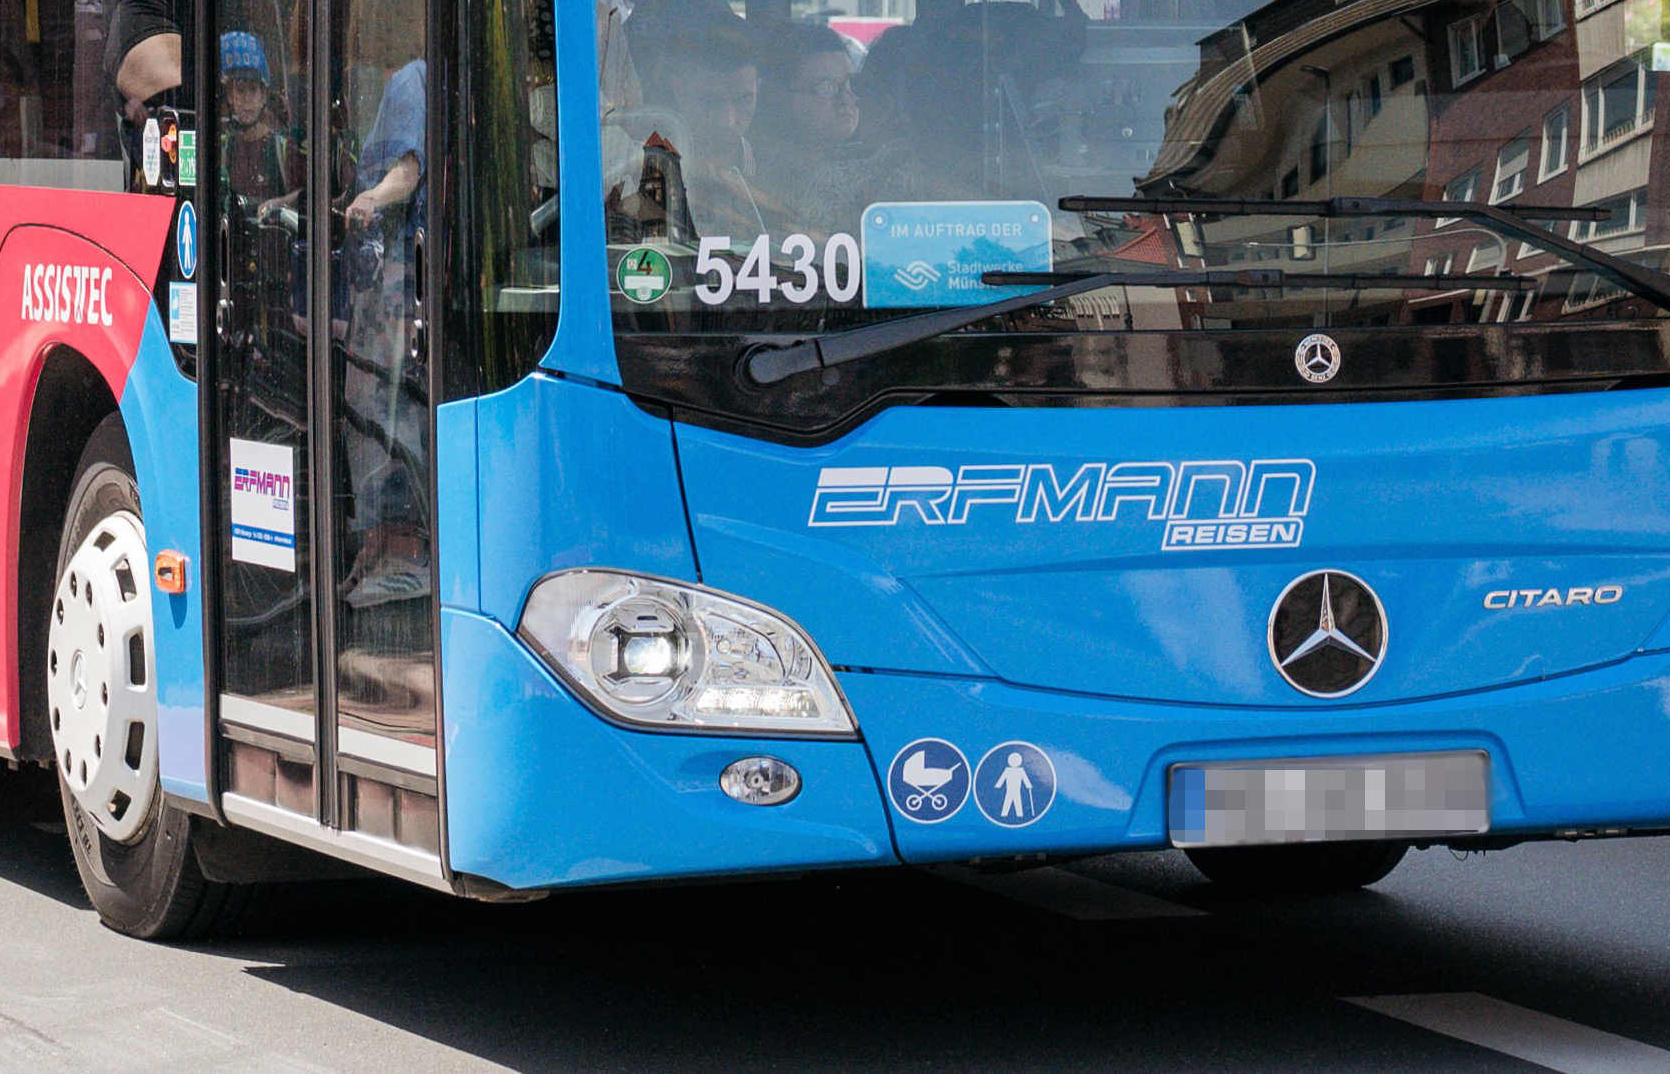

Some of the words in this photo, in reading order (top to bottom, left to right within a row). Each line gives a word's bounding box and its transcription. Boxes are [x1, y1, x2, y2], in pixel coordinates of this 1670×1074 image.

[891, 224, 908, 238] IM
[914, 223, 986, 237] AUFTRAG
[992, 222, 1022, 236] DER
[637, 251, 652, 275] 4
[694, 232, 860, 304] 5430
[234, 467, 291, 499] ERFMANN
[808, 459, 1316, 527] ERFMANN
[1170, 523, 1297, 544] REISEN
[1482, 585, 1623, 610] CITARO
